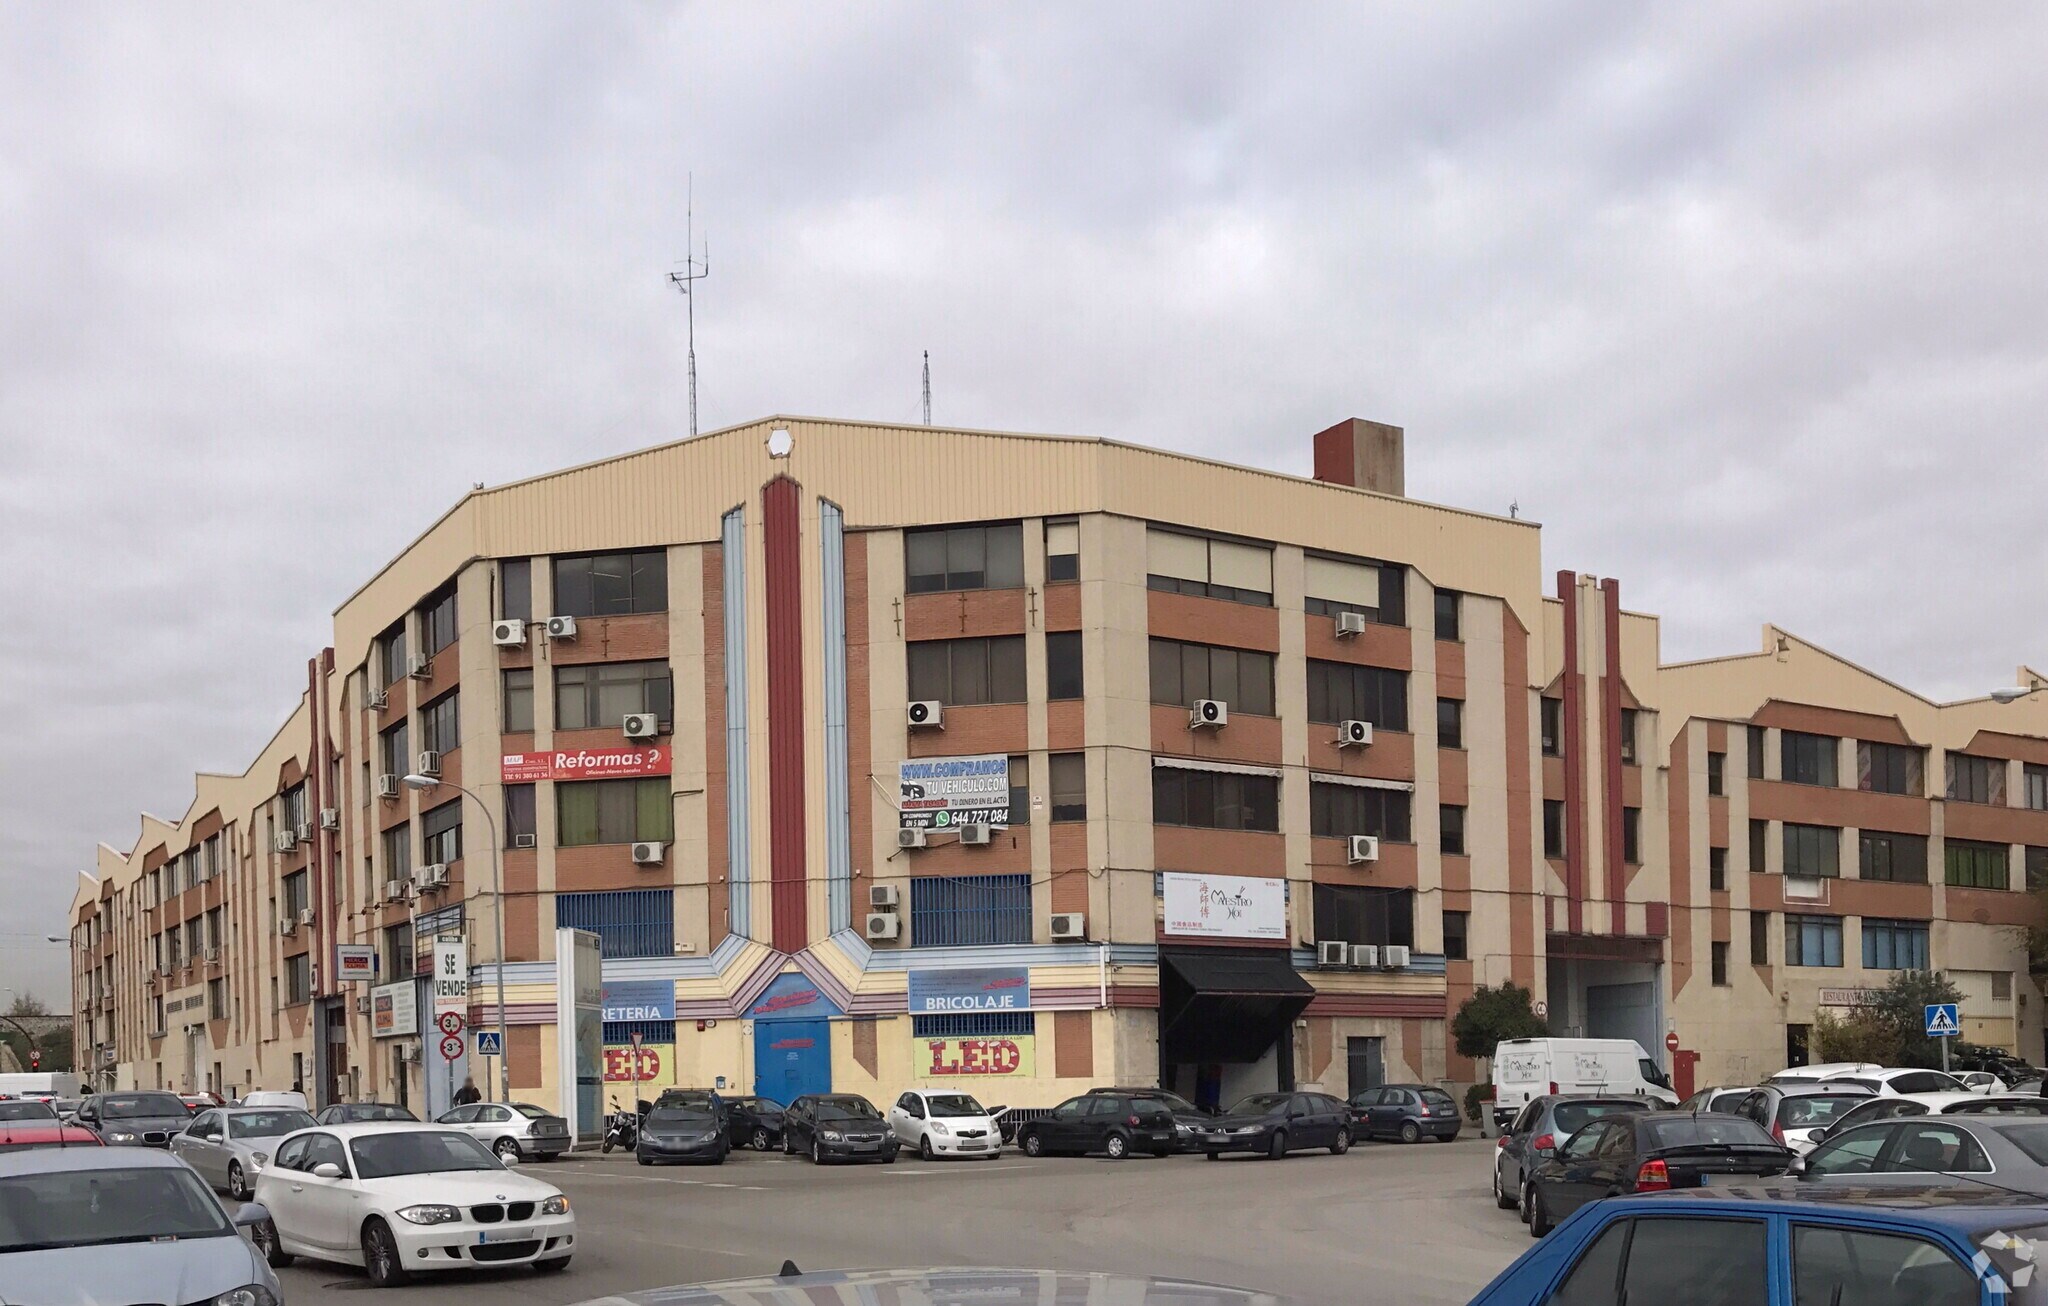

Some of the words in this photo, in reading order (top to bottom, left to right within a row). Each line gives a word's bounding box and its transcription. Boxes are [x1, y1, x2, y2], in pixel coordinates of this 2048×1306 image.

[555, 751, 643, 769] Reformas
[901, 759, 1007, 779] WWW.COMPRAMOS
[926, 780, 938, 795] TU
[979, 797, 986, 805] EN
[993, 796, 1007, 804] ACTO
[951, 811, 969, 825] 644
[971, 810, 989, 824] 727
[990, 808, 1008, 823] 084
[1210, 889, 1253, 907] MAESTRO
[444, 954, 456, 975] SE
[435, 980, 466, 997] VENDE
[926, 995, 1014, 1011] BRICOLAJE
[445, 1019, 452, 1028] 3
[447, 1043, 454, 1051] 3
[929, 1040, 1020, 1075] LED
